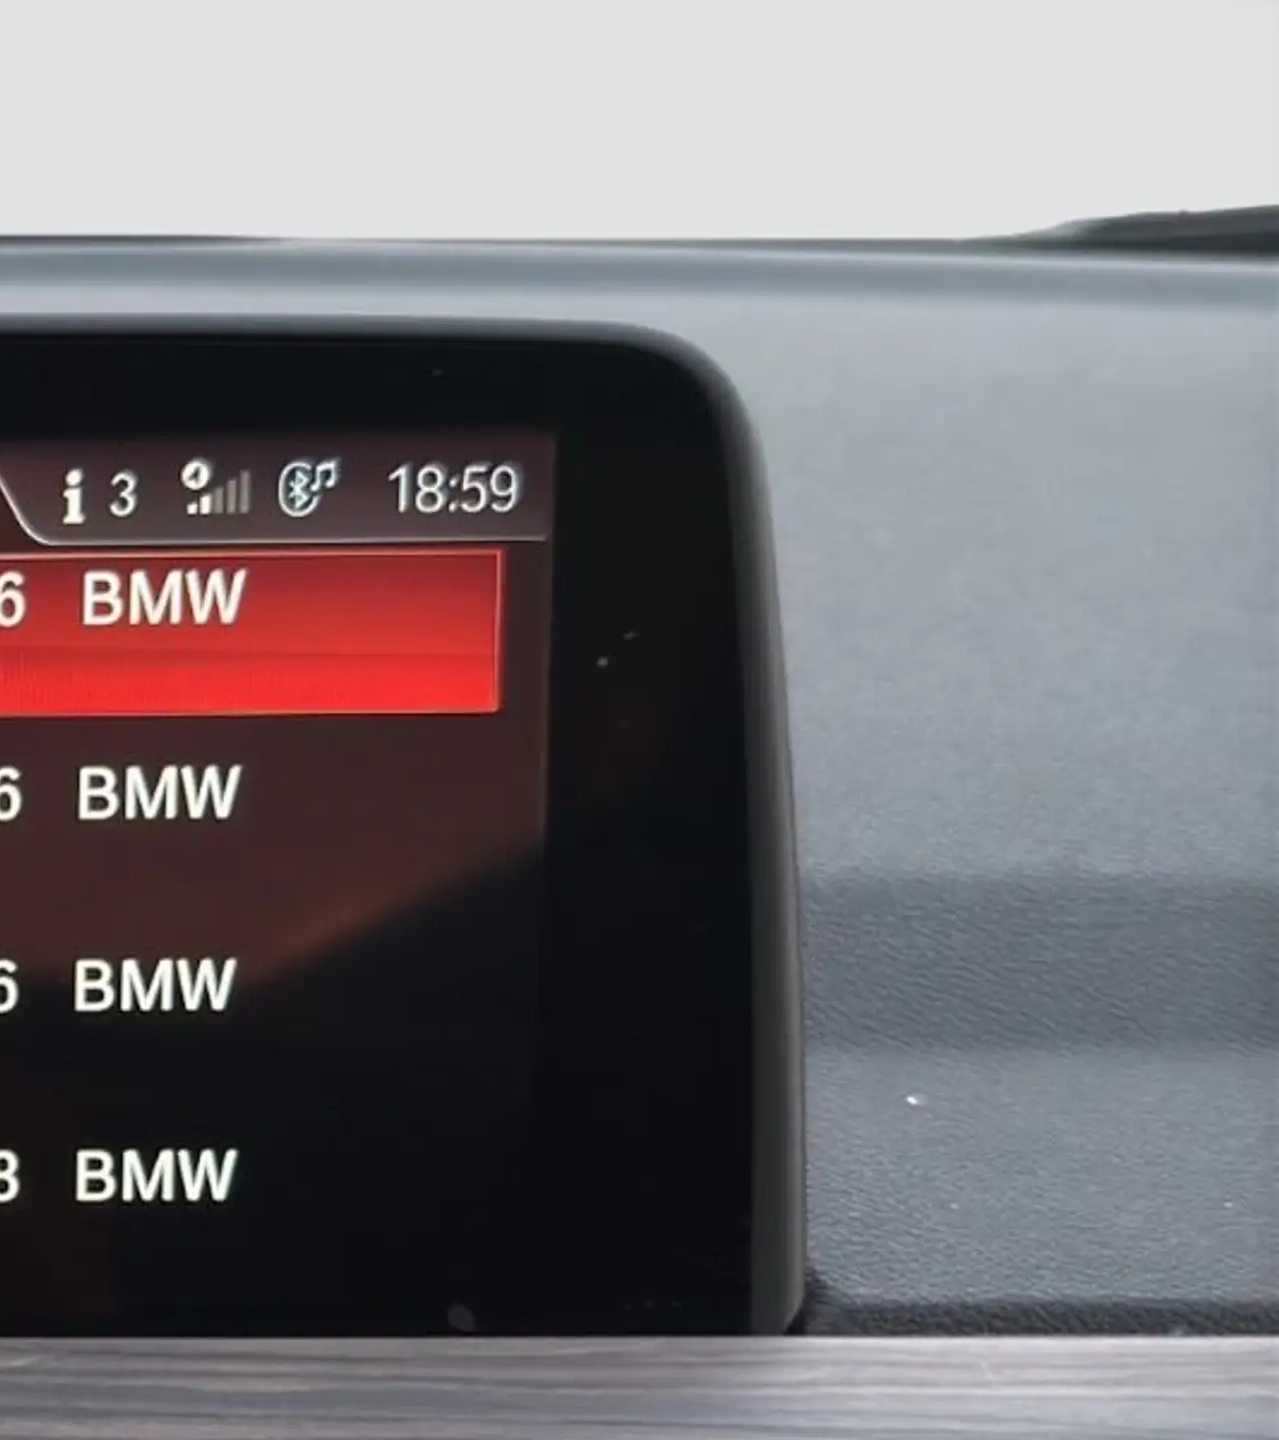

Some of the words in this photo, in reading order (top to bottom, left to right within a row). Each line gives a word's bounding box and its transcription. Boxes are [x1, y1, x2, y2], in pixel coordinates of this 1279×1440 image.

[108, 470, 138, 519] 3
[387, 462, 521, 515] 18:59
[81, 567, 249, 628] BMW
[76, 762, 244, 822] BMW
[72, 955, 239, 1014] BMW
[74, 1146, 240, 1204] BMW
